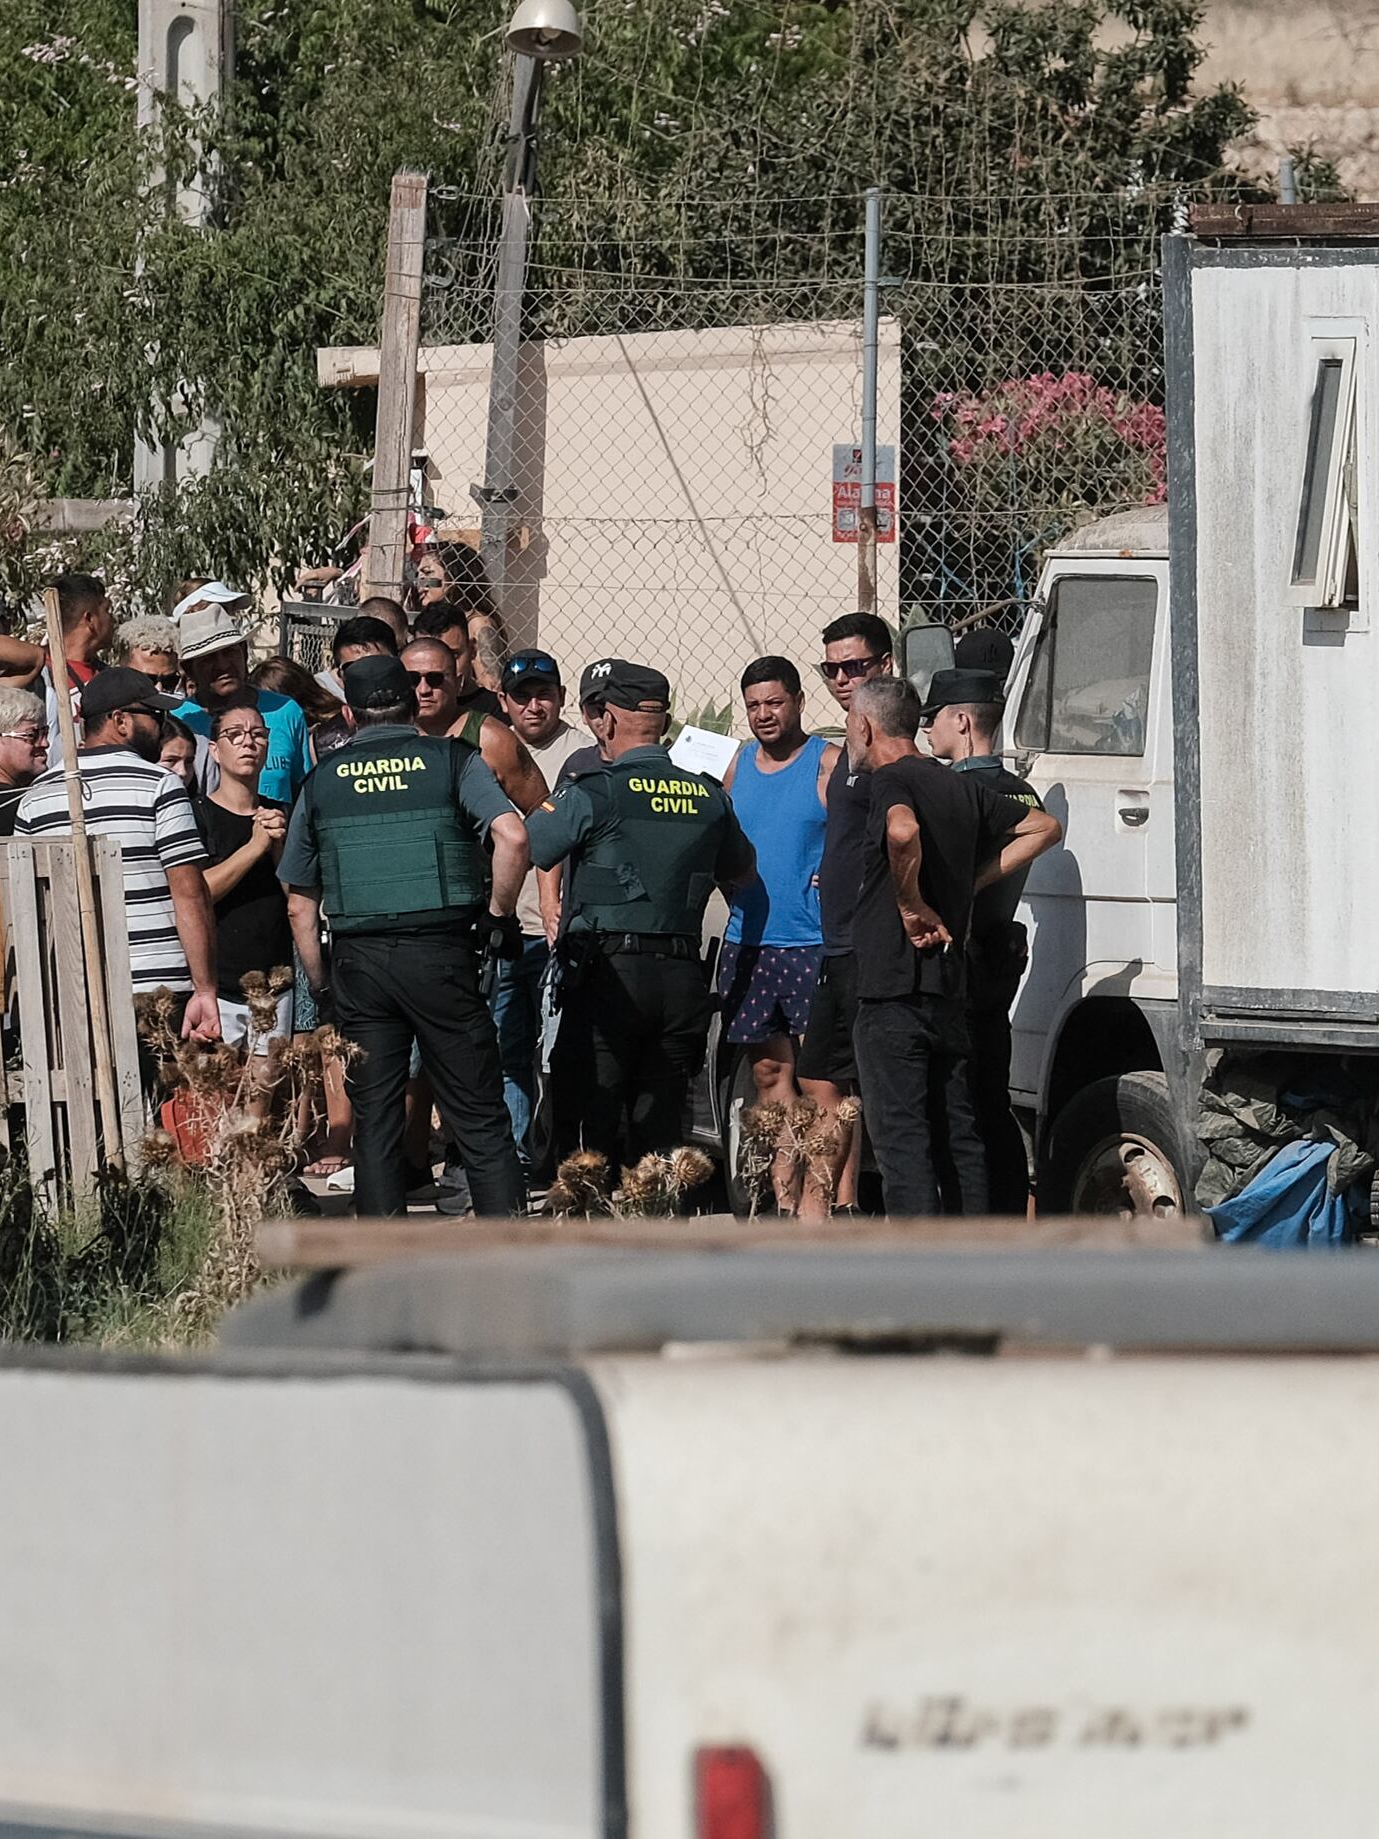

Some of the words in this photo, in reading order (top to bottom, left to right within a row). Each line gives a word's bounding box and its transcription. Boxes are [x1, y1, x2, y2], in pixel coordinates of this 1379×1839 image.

[837, 486, 891, 499] Alaa
[264, 756, 287, 771] LUB
[336, 756, 427, 778] GUARDIA
[353, 775, 409, 794] CIVIL
[628, 778, 710, 798] GUARDIA
[650, 797, 699, 814] CIVIL
